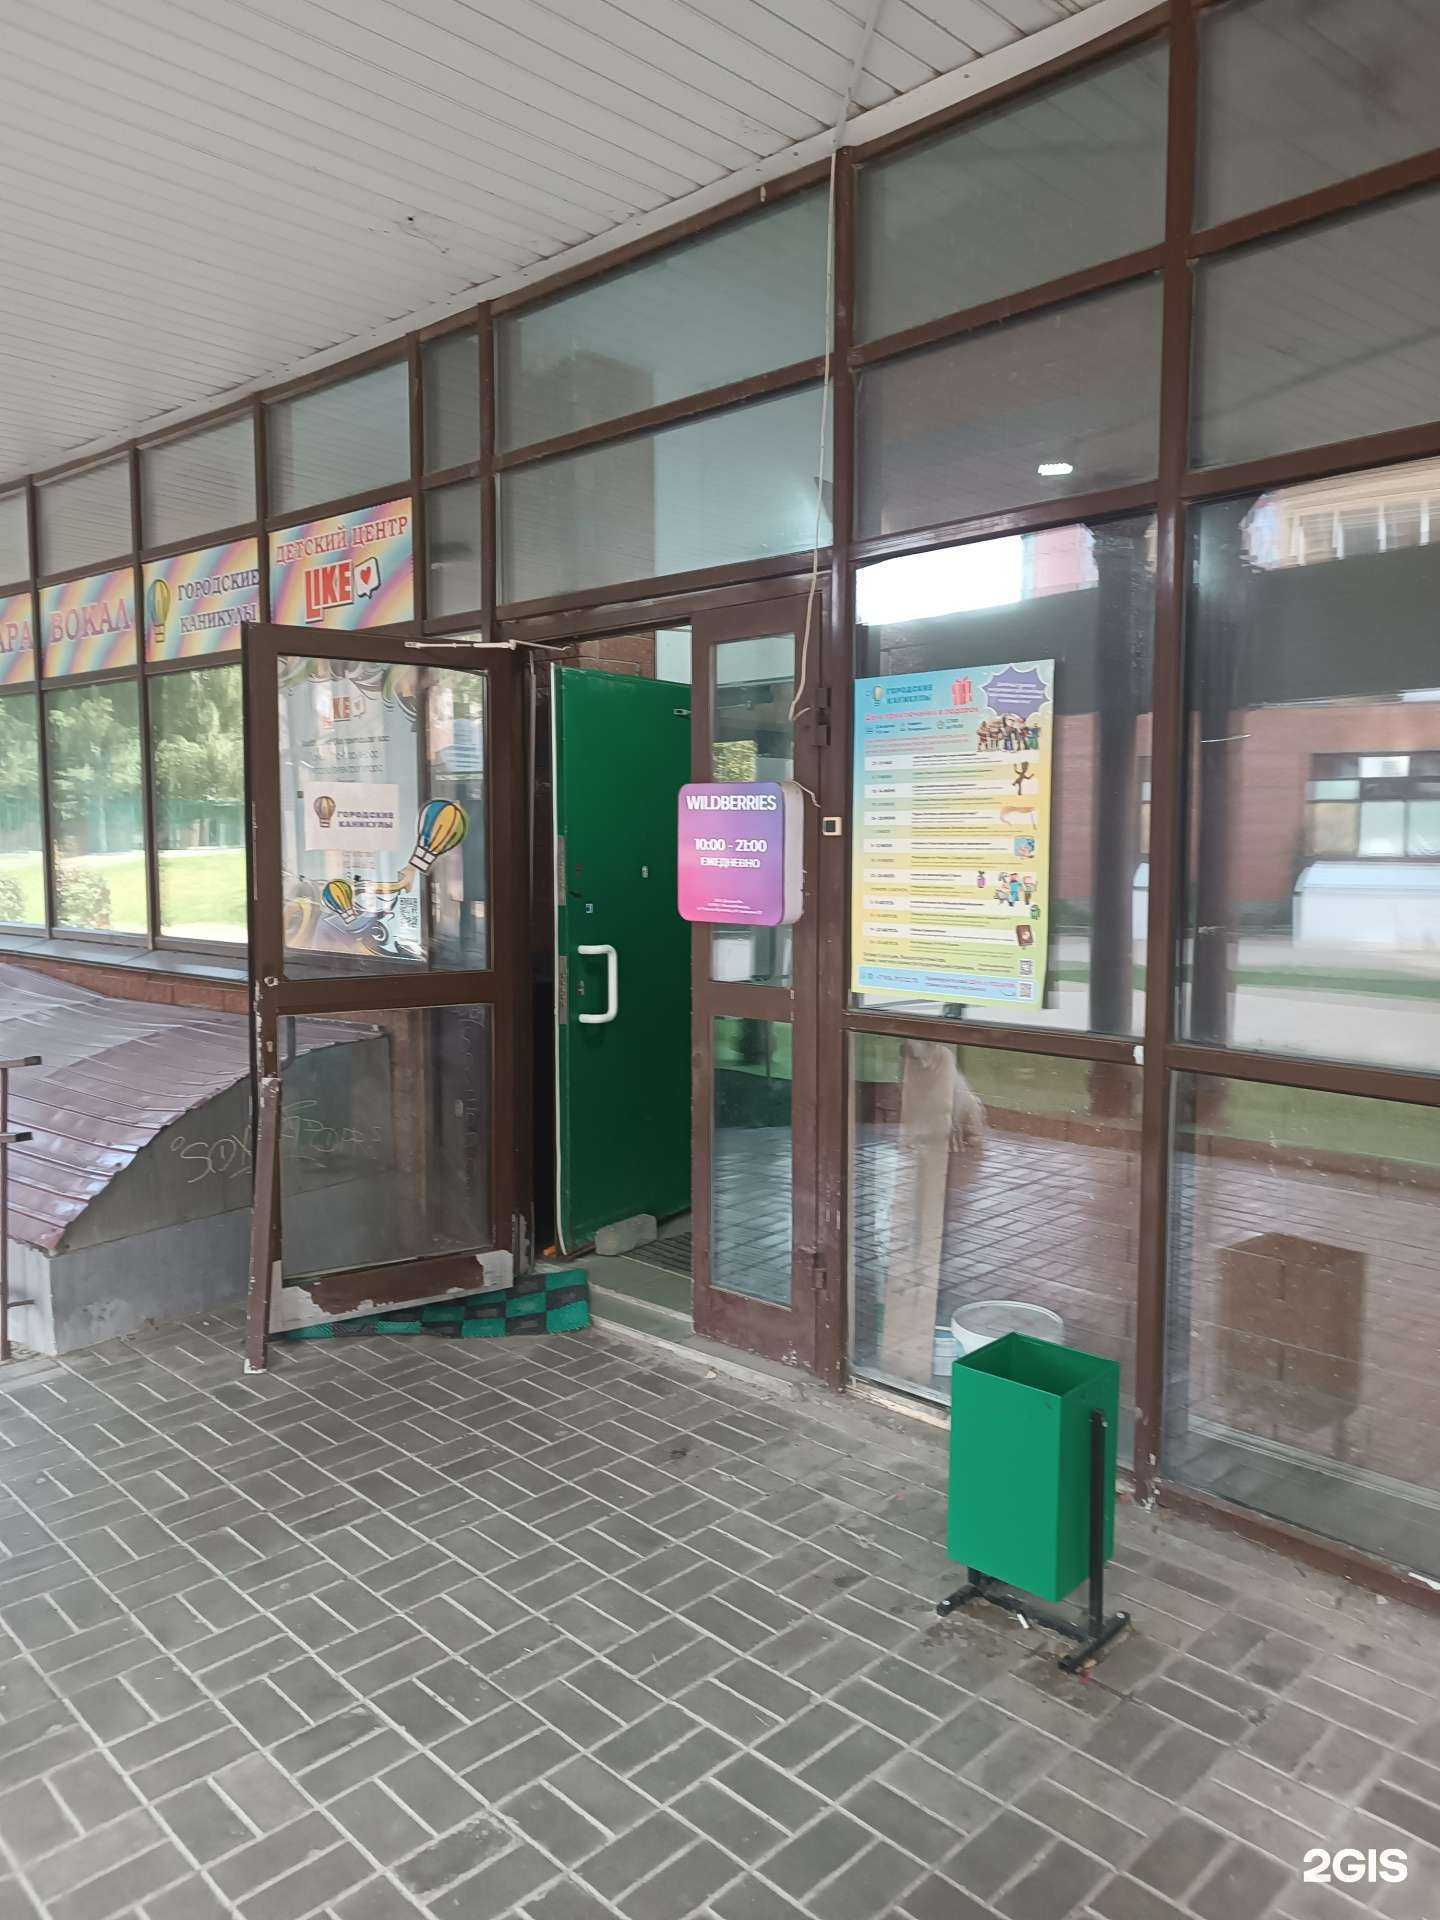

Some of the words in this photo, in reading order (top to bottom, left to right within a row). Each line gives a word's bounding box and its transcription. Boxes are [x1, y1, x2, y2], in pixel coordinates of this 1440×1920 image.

[276, 525, 348, 564] ДЕТСКИЙ
[351, 516, 408, 547] ЦЕНТР
[177, 569, 260, 601] ГОРОДСКИЕ
[304, 560, 354, 621] LIKE
[48, 597, 132, 645] ВОКАЛ
[180, 603, 257, 634] КАНИКУЛЫ
[336, 810, 394, 819] ГОРОДСКИЕ
[686, 794, 777, 811] WILDBERRIES
[338, 821, 394, 829] КАНИКУЛЫ
[694, 838, 726, 851] 10:00
[735, 839, 768, 852] 21:00
